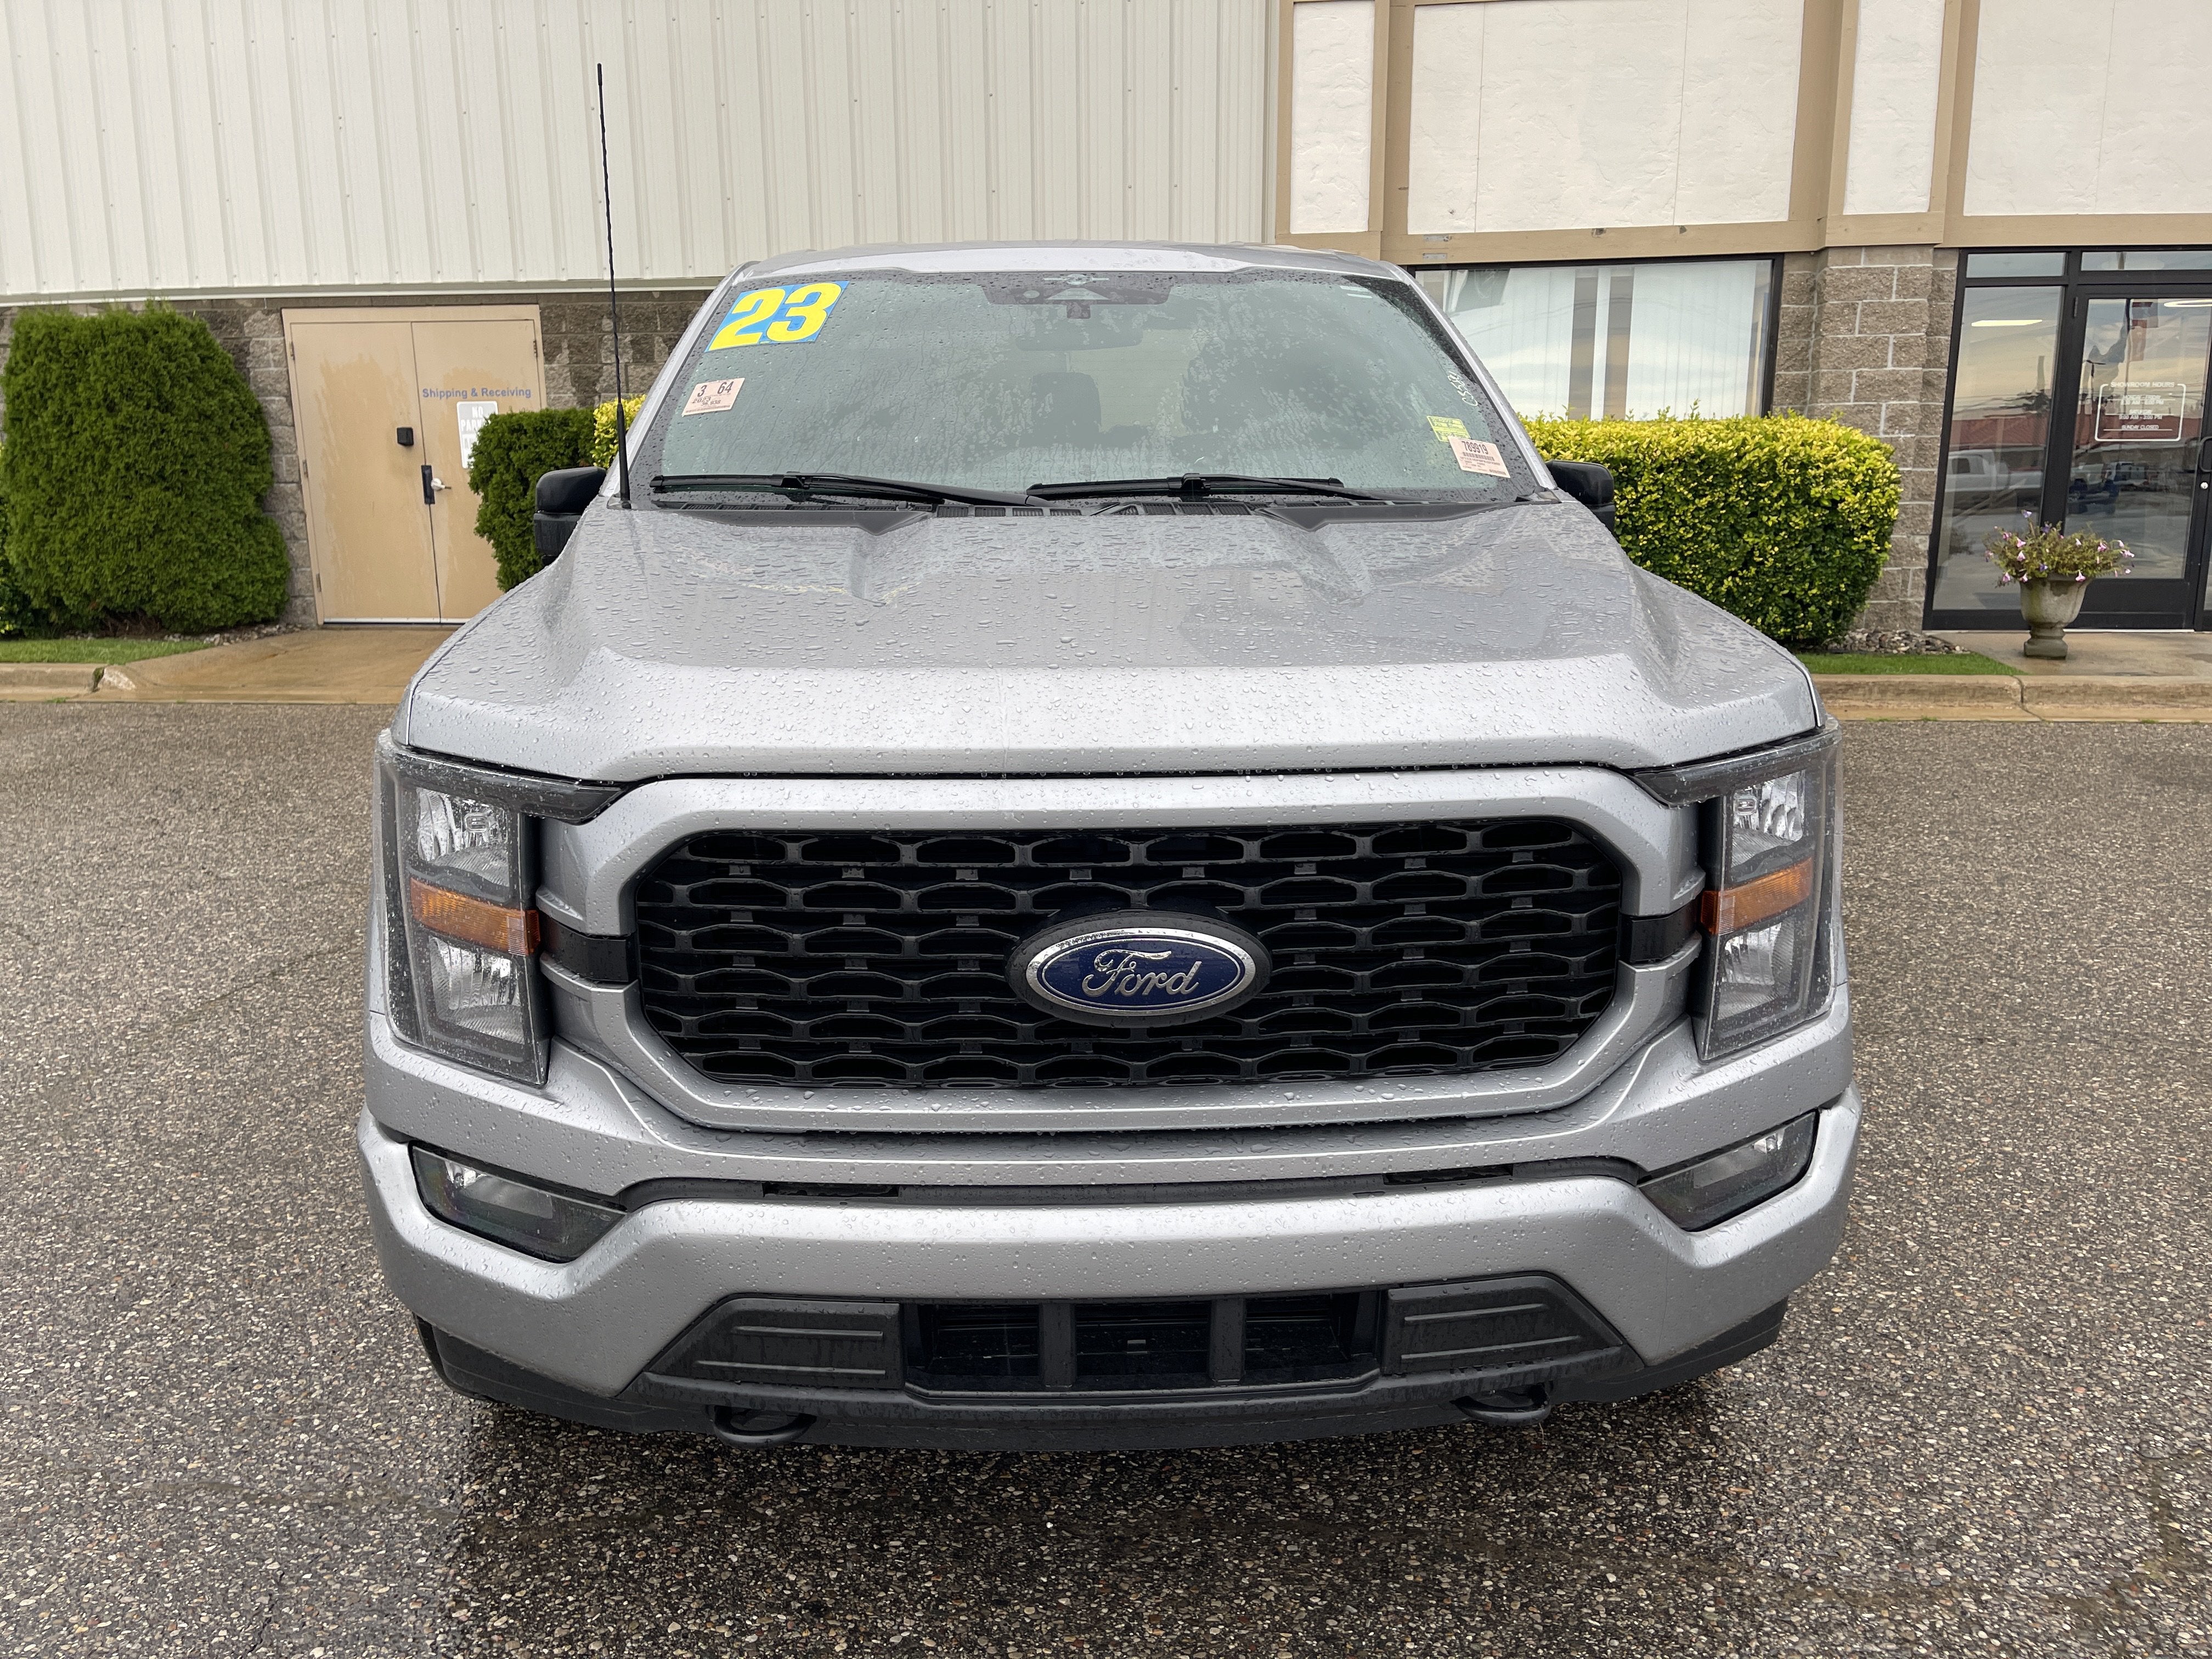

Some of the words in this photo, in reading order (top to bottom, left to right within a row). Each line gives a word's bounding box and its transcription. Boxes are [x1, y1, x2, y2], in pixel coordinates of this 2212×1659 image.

[708, 282, 842, 352] 23
[422, 388, 467, 399] Shipping
[471, 387, 478, 397] &
[481, 387, 532, 398] Receiving
[697, 385, 708, 397] 3
[717, 381, 734, 394] 64
[472, 406, 483, 418] NO
[460, 419, 488, 432] PARK
[1462, 441, 1488, 454] 789919
[1081, 949, 1202, 998] Ford
